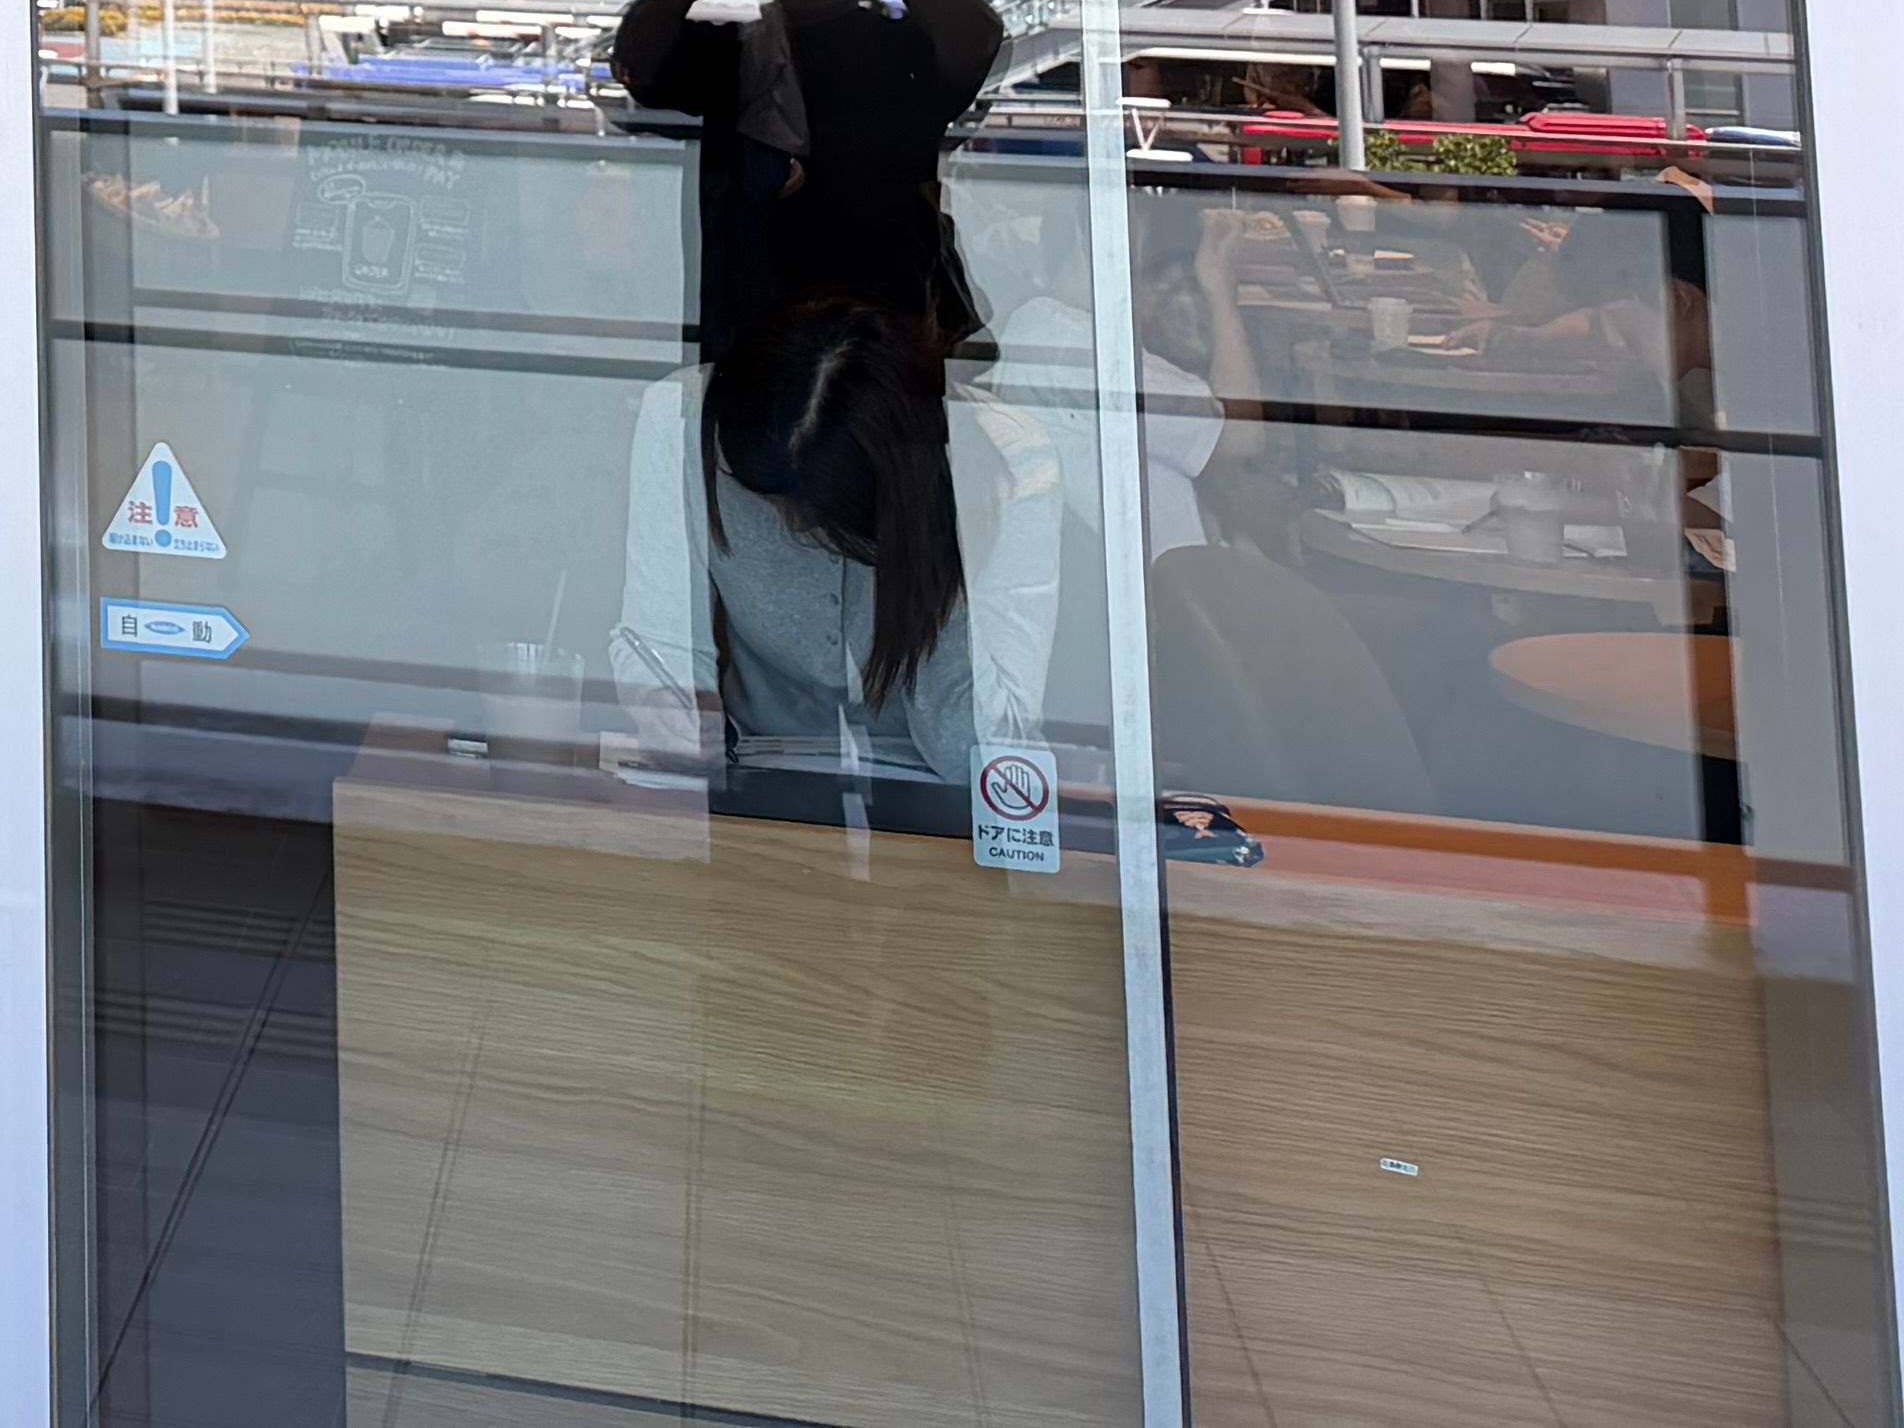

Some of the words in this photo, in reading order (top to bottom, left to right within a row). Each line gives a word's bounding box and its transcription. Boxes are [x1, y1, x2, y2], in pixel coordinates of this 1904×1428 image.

[978, 823, 1055, 848] ドアに注意
[988, 846, 1046, 862] CAUTION
